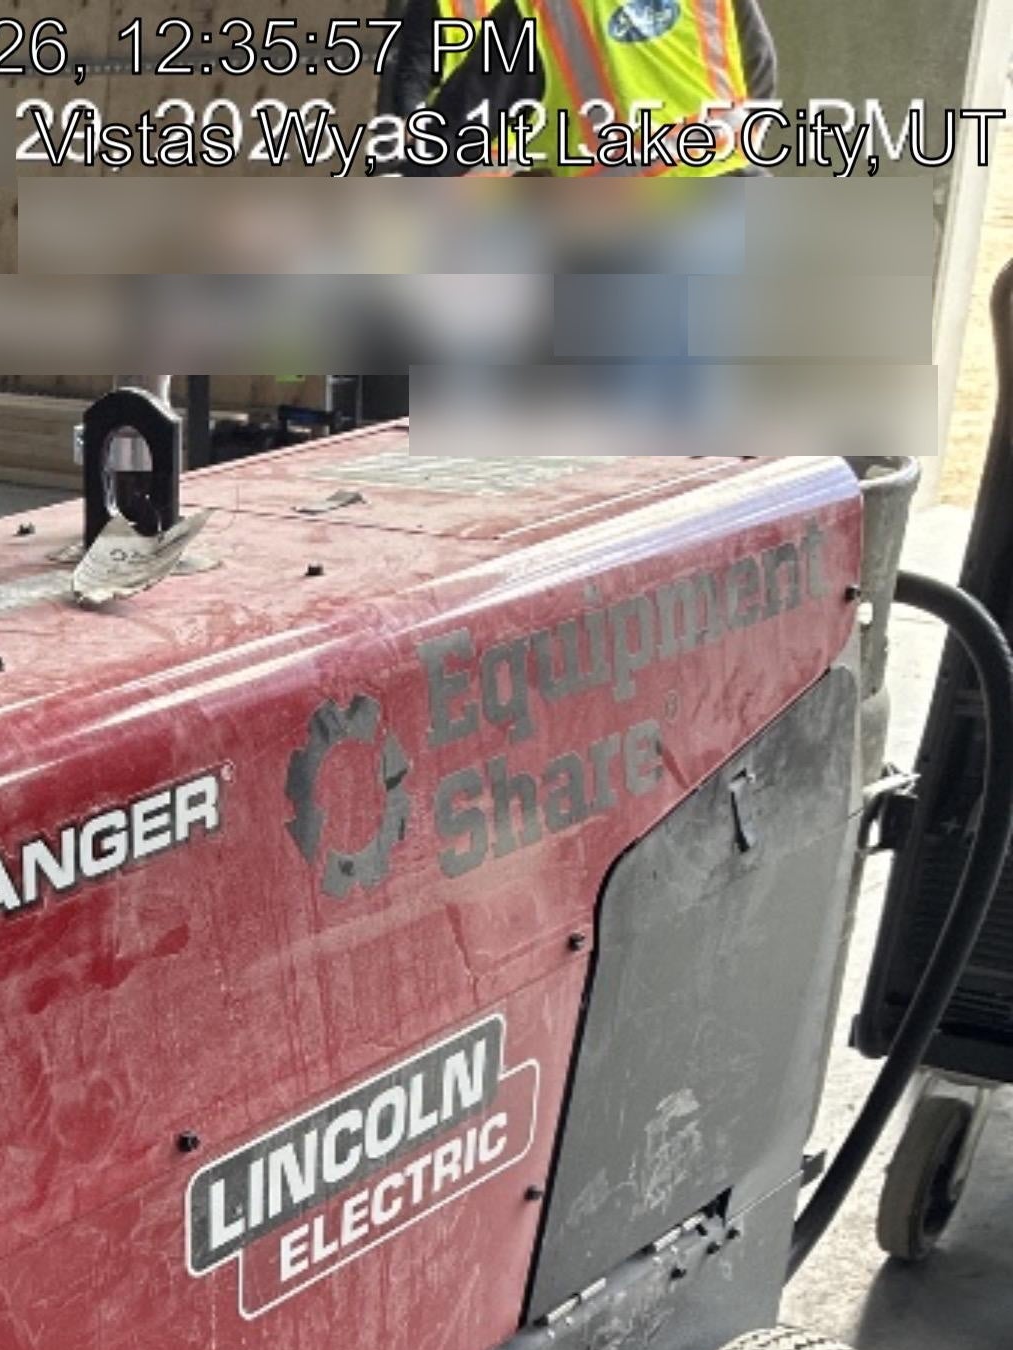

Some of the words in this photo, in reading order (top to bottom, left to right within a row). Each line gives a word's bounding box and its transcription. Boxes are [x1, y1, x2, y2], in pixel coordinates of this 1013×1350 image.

[418, 517, 830, 747] Equipment
[432, 718, 664, 880] Share
[209, 1038, 486, 1251] LINCOLN
[280, 1112, 508, 1282] ELECTRIC
